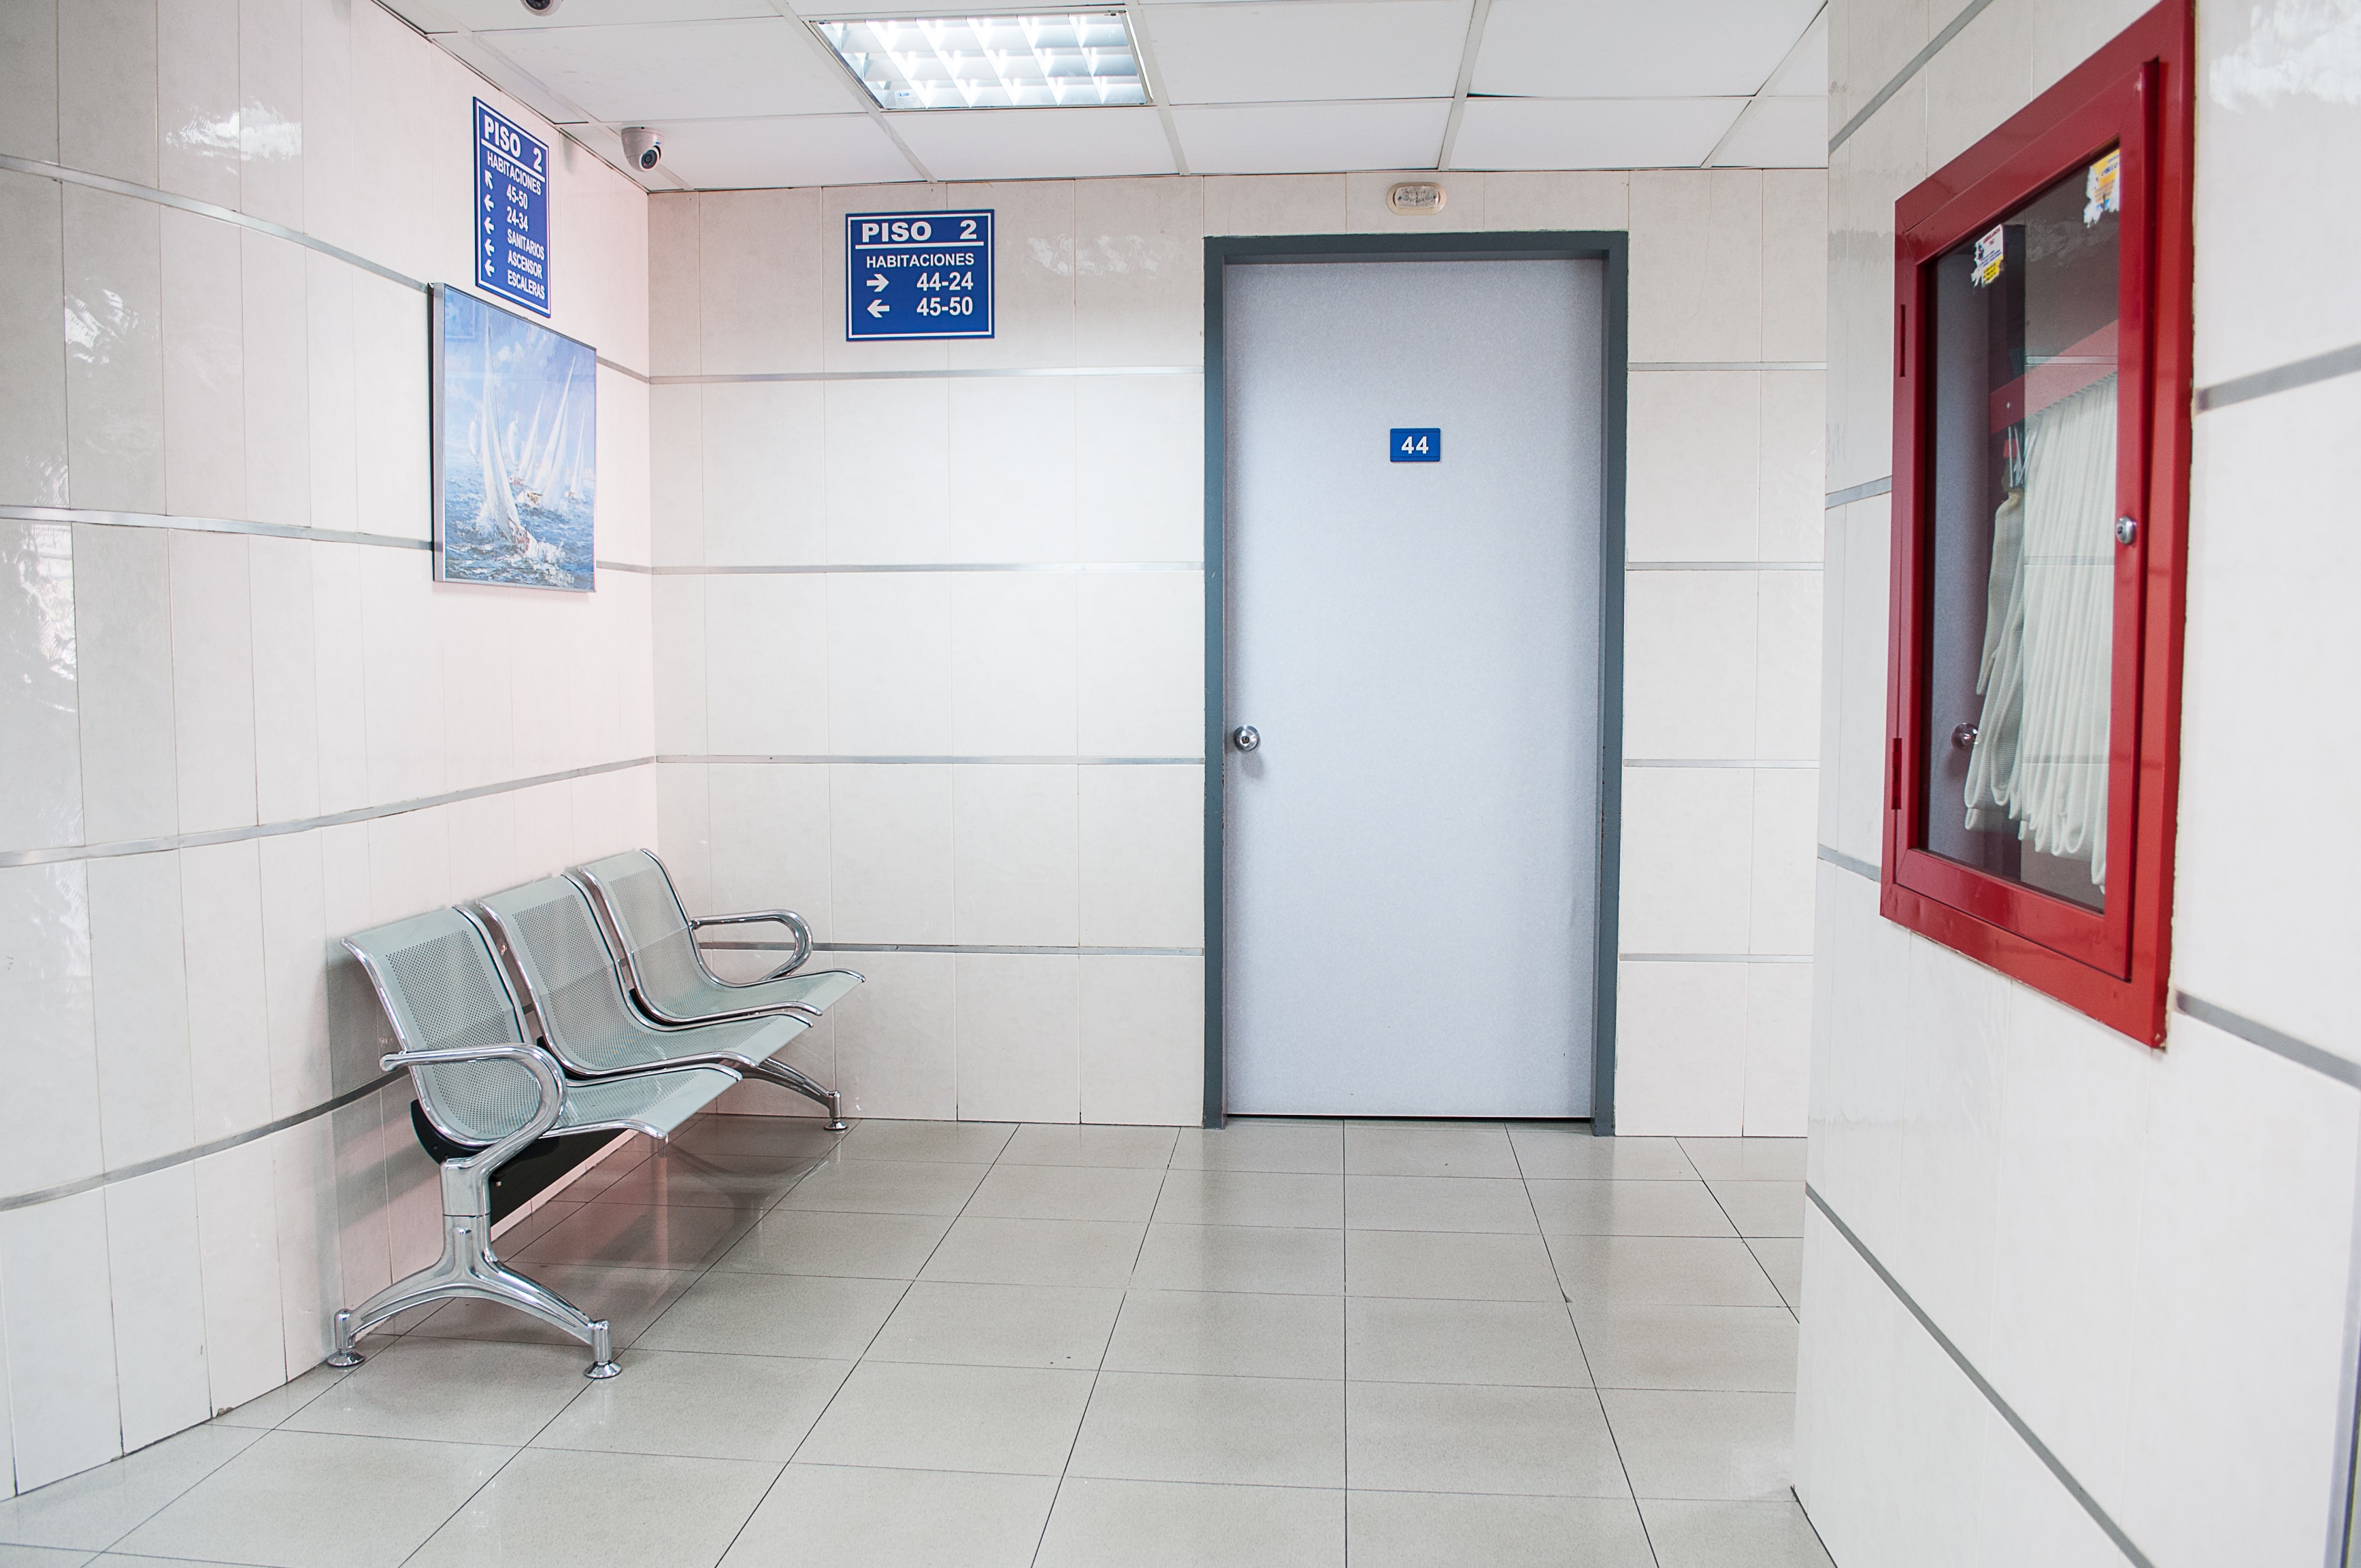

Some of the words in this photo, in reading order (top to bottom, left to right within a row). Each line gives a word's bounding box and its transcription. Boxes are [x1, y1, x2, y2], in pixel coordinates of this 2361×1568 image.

[484, 115, 521, 158] PISO
[533, 148, 542, 173] 2
[487, 150, 542, 195] HABITACIONES
[507, 184, 528, 210] 45-50
[507, 206, 528, 231] 24-34
[862, 221, 931, 243] PISO
[960, 220, 977, 239] 2
[508, 229, 544, 260] SANITARIOS
[508, 250, 542, 279] ASCENSOR
[866, 253, 974, 268] HABITACIONES
[508, 270, 545, 299] ESCALERAS
[917, 271, 974, 291] 44-24
[917, 297, 973, 316] 45-50
[1402, 436, 1429, 454] 44
